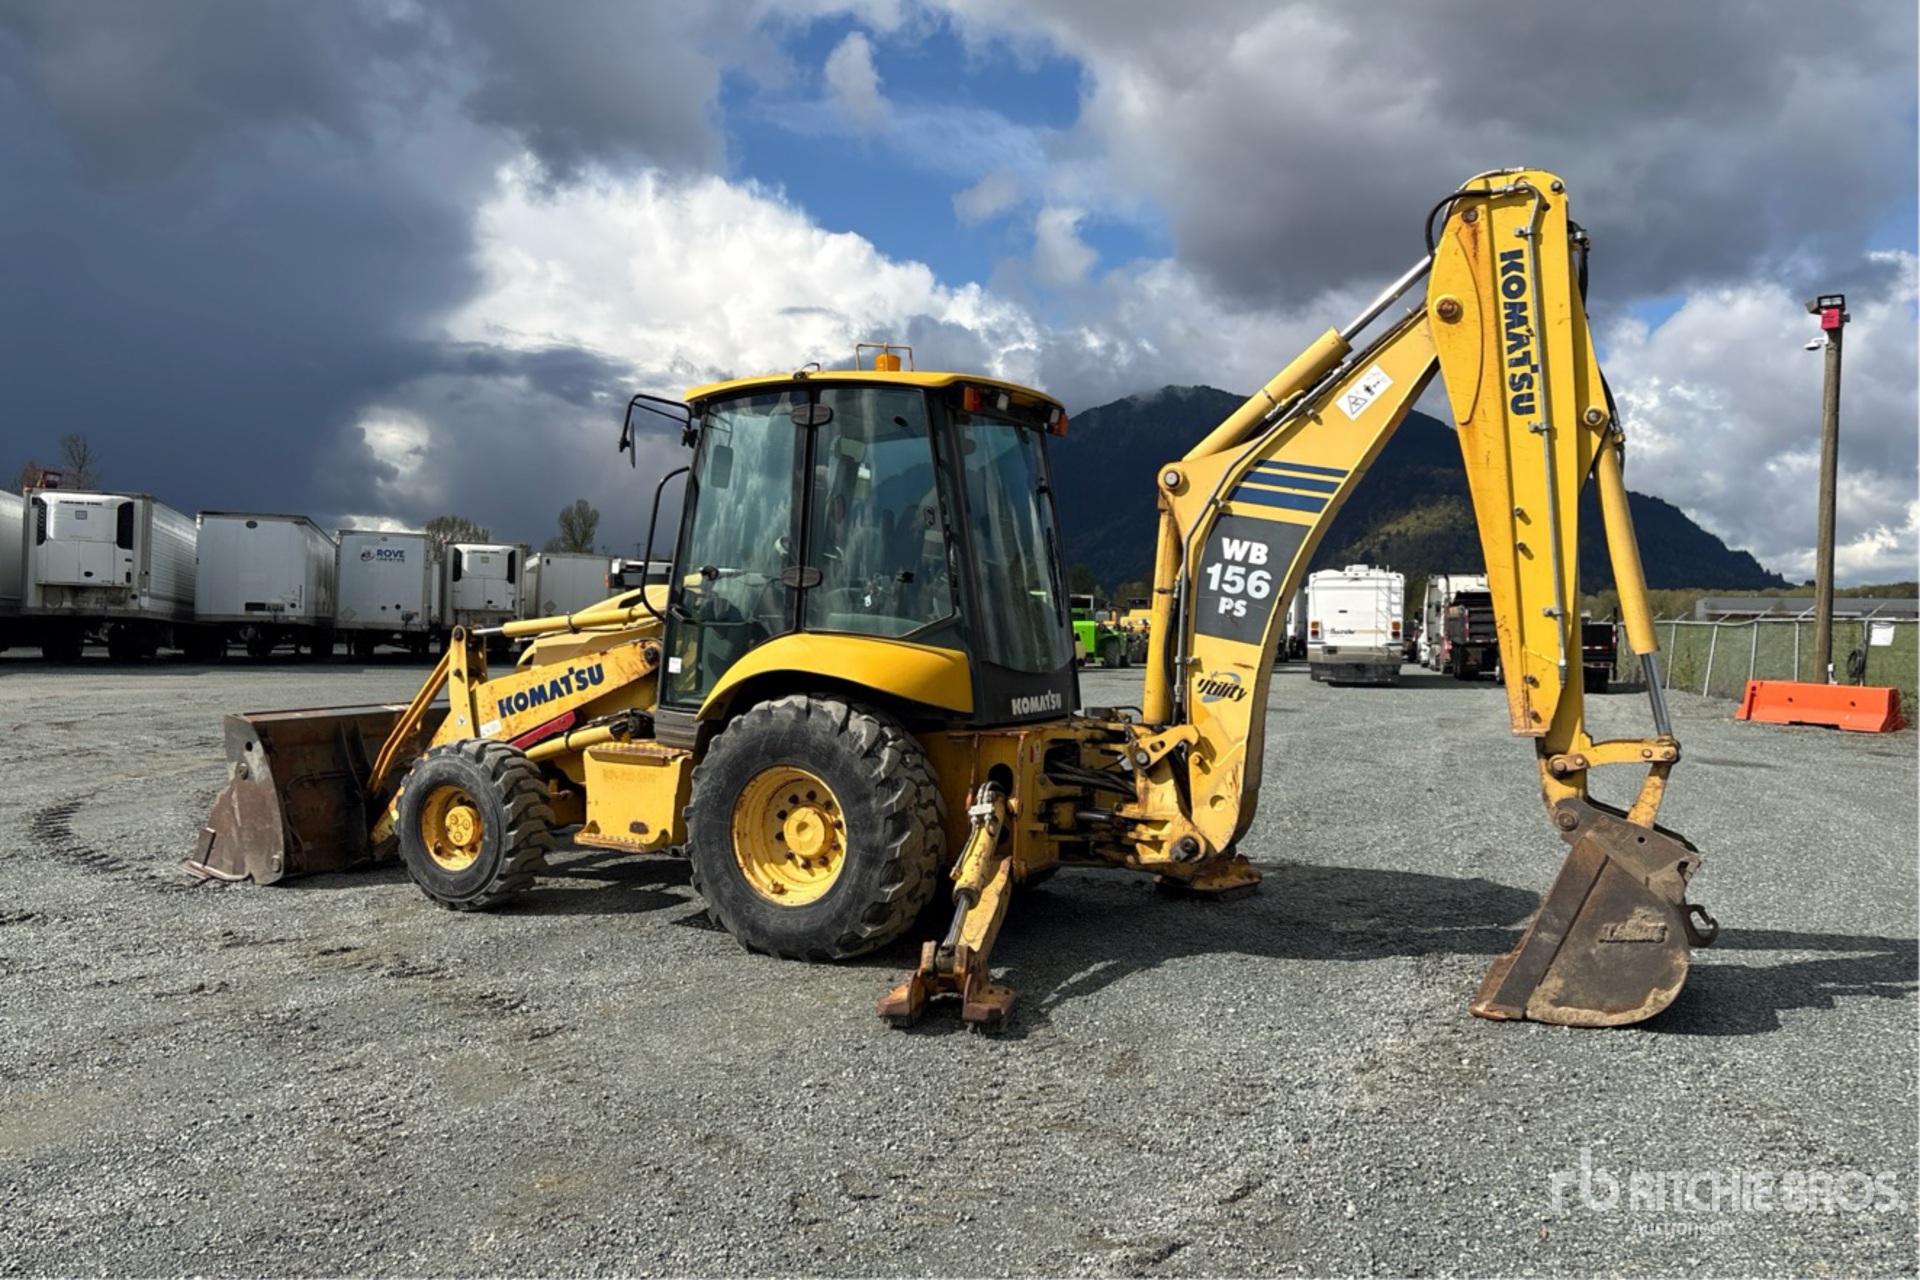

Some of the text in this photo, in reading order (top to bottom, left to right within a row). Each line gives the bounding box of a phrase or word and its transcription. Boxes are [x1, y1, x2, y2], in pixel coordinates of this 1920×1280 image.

[1500, 249, 1539, 416] KOMATSU
[376, 549, 405, 558] ROVE
[1222, 537, 1269, 565] WB
[1206, 562, 1272, 600] 156
[1218, 596, 1247, 617] PS
[497, 662, 605, 719] KOMATSU
[1011, 690, 1062, 716] KOMATSU
